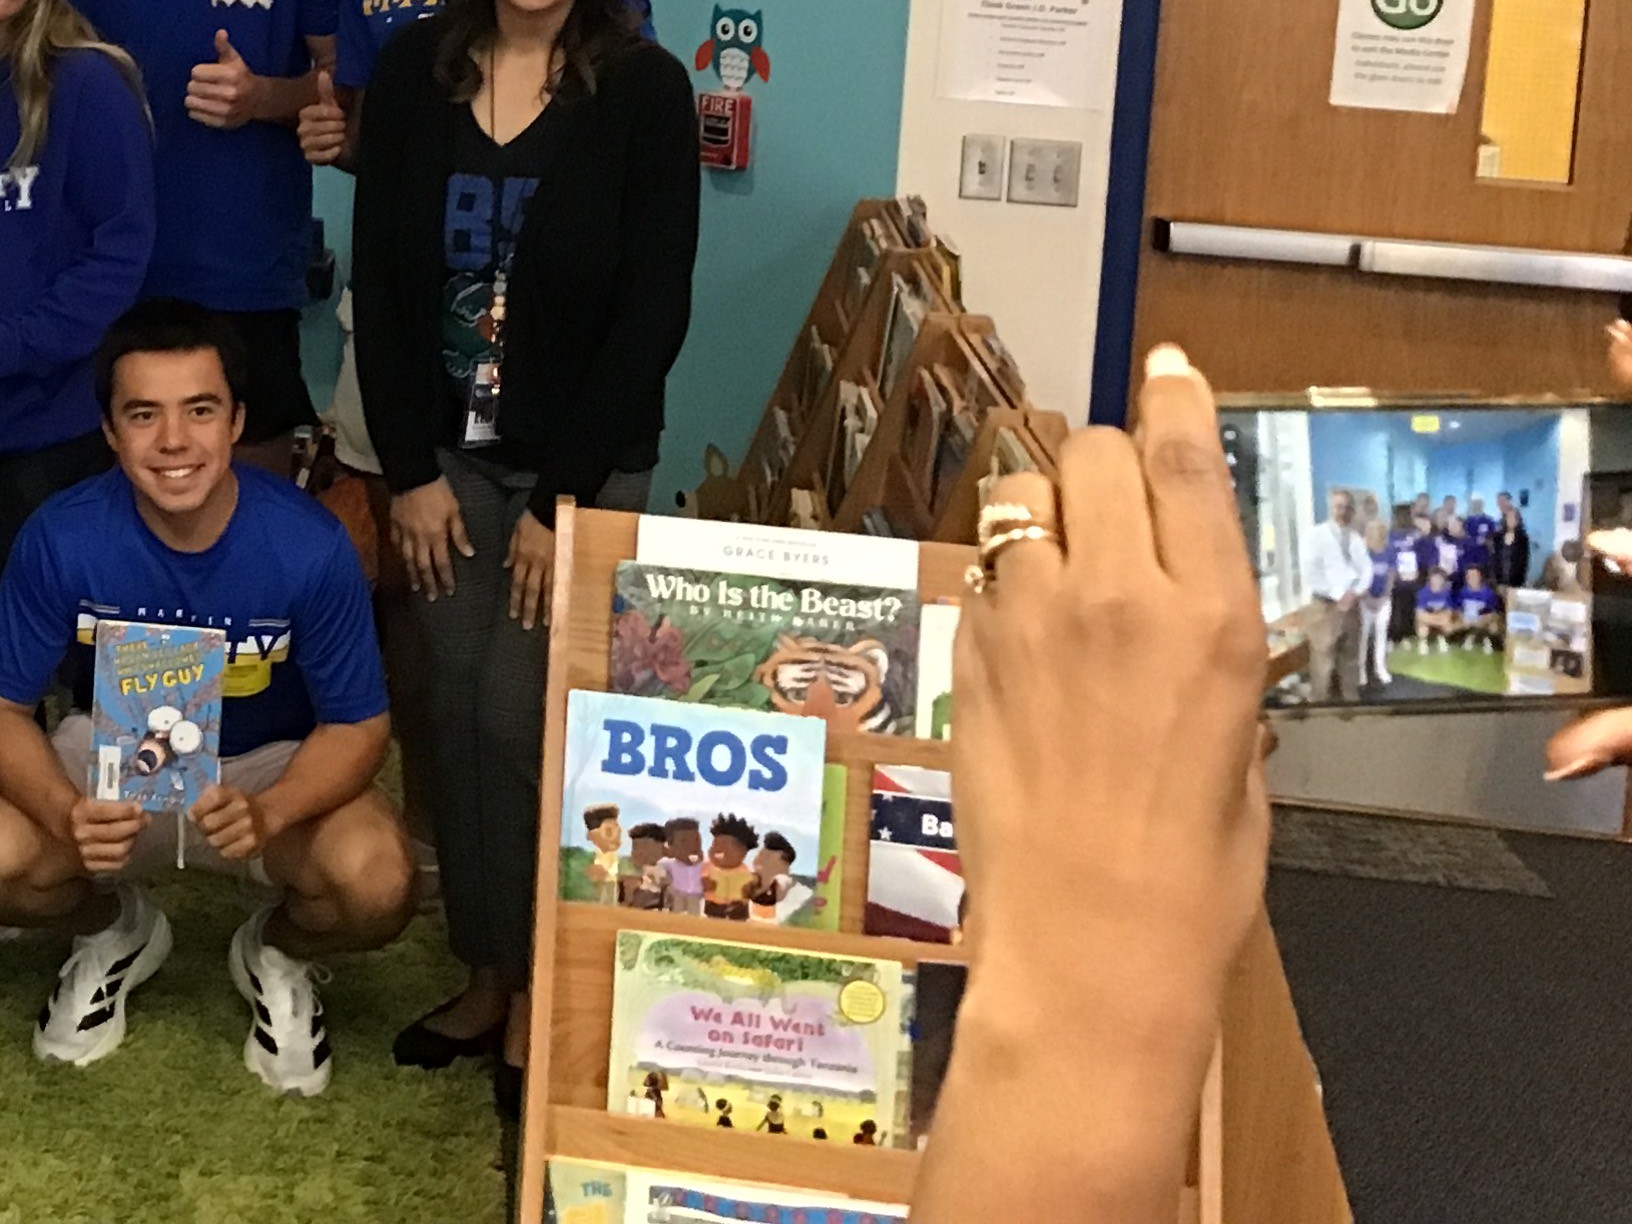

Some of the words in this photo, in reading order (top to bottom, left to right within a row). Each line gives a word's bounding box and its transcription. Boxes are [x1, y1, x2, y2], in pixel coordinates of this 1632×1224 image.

[702, 96, 734, 114] FIRE
[723, 546, 774, 560] GRACE
[783, 552, 829, 565] BYERS
[645, 573, 711, 603] Who
[718, 580, 743, 606] Is
[750, 584, 793, 611] the
[800, 588, 902, 622] Beast?
[121, 673, 158, 695] FLY
[162, 664, 204, 688] GUY
[601, 718, 790, 793] BROS
[691, 1005, 722, 1025] We
[730, 1011, 761, 1029] All
[769, 1016, 825, 1036] Went
[707, 1029, 734, 1044] on
[742, 1032, 804, 1052] Safari
